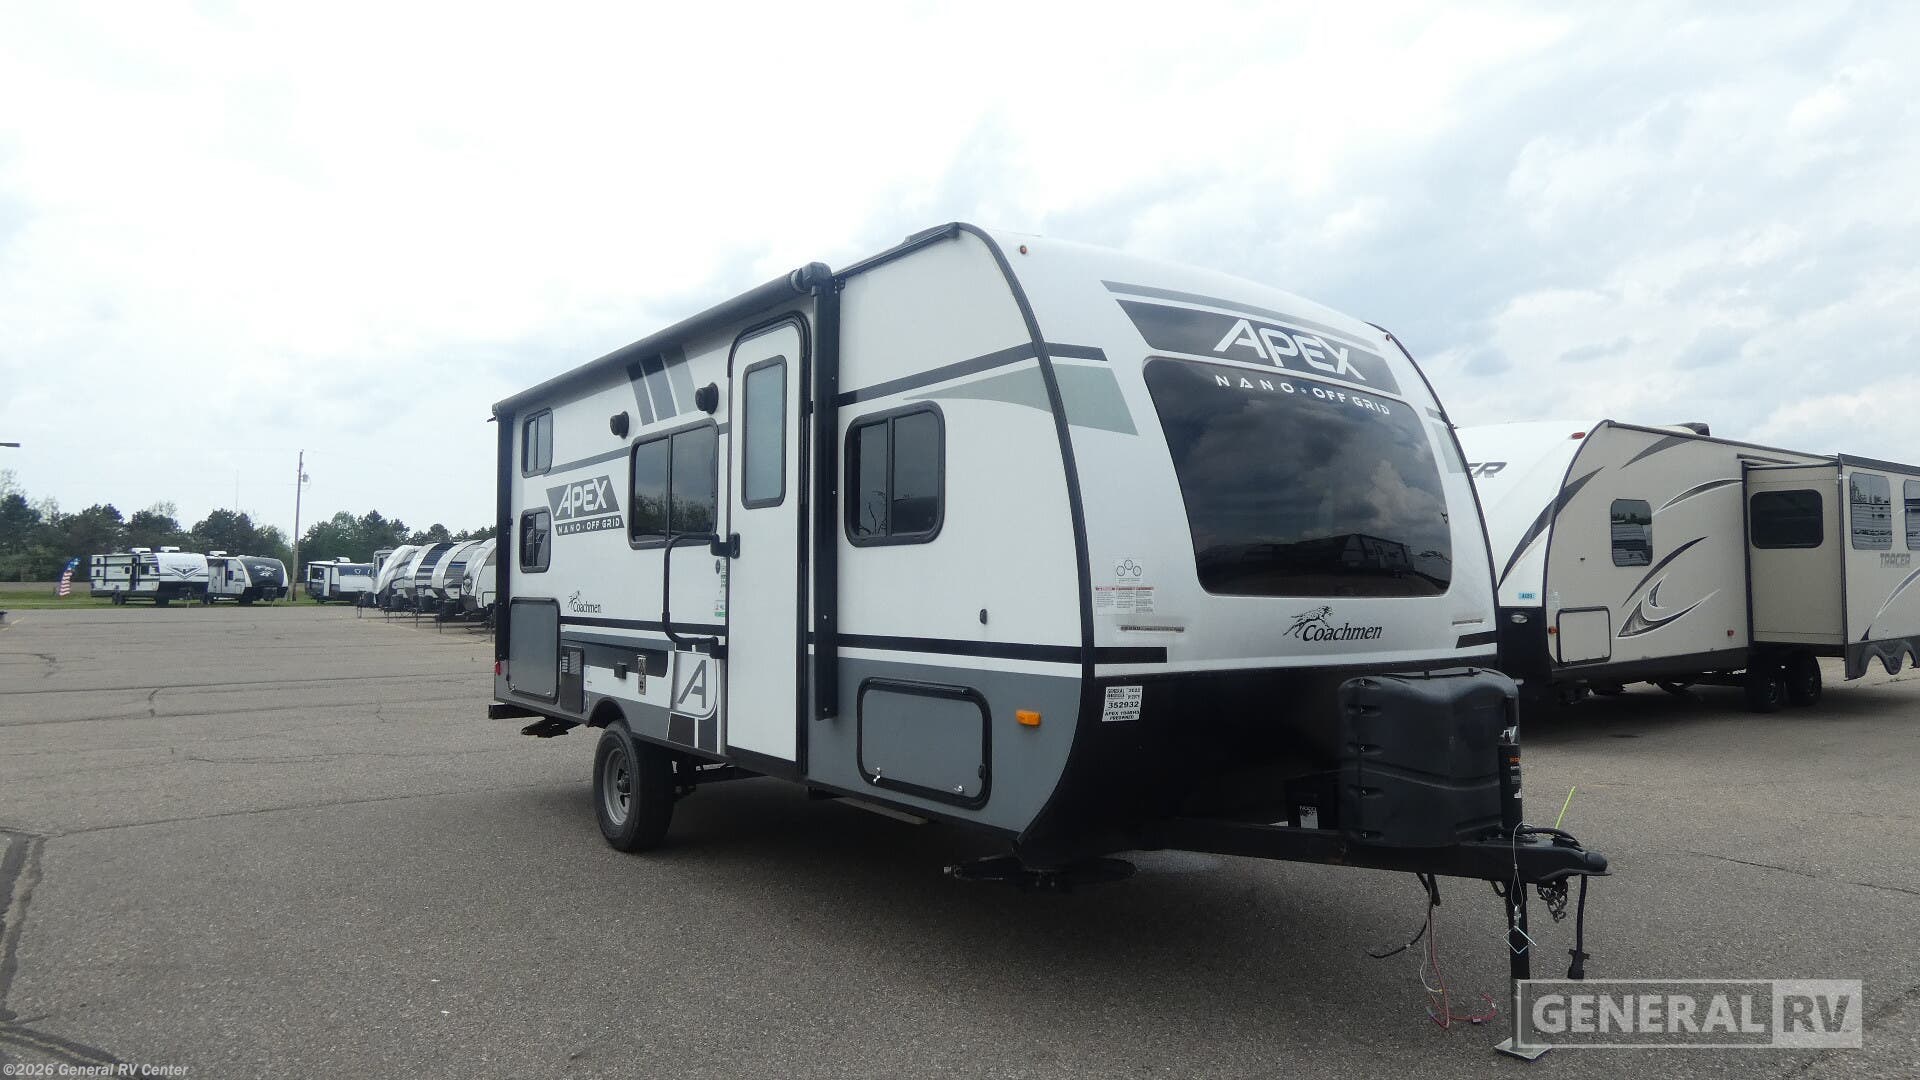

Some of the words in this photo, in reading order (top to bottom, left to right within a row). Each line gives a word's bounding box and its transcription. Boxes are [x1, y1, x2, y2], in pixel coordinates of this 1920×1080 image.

[1213, 319, 1366, 380] APEX
[1215, 375, 1294, 394] NANO
[1313, 387, 1346, 403] OFF
[1353, 396, 1390, 416] GRID
[555, 479, 608, 518] APEX
[558, 523, 581, 535] NANO
[586, 521, 600, 531] OFF
[601, 517, 620, 528] GRID
[1880, 552, 1911, 568] TRACER
[573, 600, 602, 613] Coachmen
[1302, 622, 1383, 642] Coachmen
[1108, 701, 1139, 709] 352932
